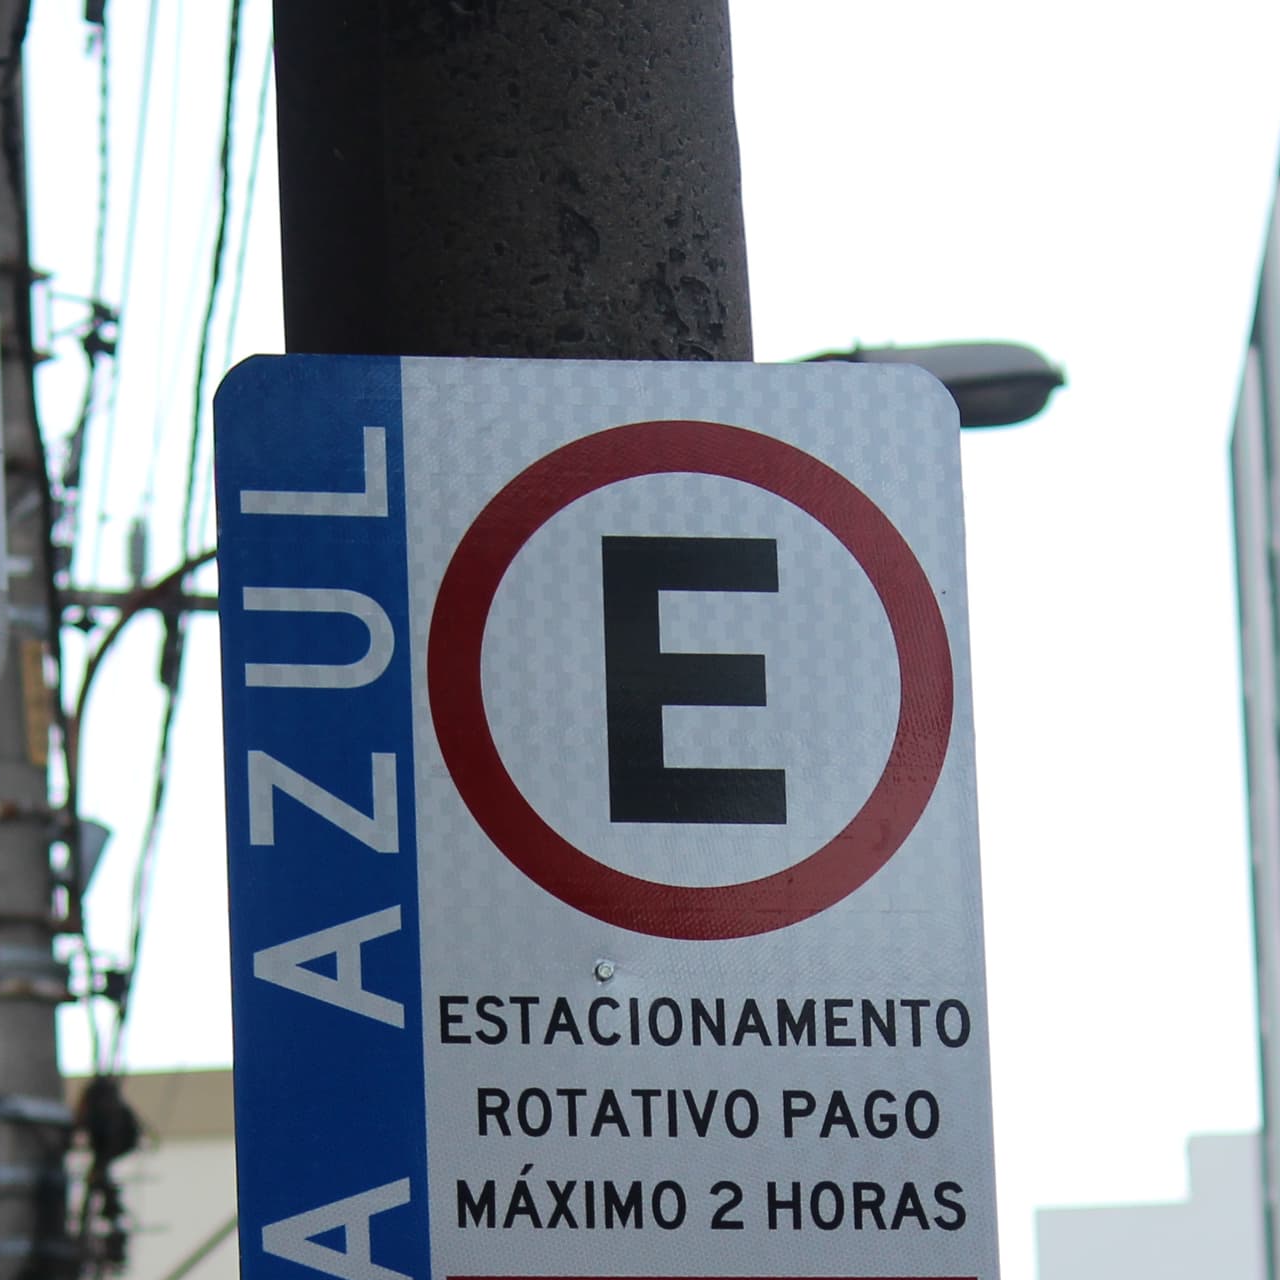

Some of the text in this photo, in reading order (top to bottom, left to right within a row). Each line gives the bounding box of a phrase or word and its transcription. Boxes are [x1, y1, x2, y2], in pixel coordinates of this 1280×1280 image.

[600, 534, 788, 826] E
[238, 425, 407, 1031] AZUL
[438, 994, 972, 1049] ESTACIONAMENTO
[476, 1086, 941, 1141] ROTATIVO PAGO
[455, 1162, 968, 1233] MÁXIMO 2 HORAS
